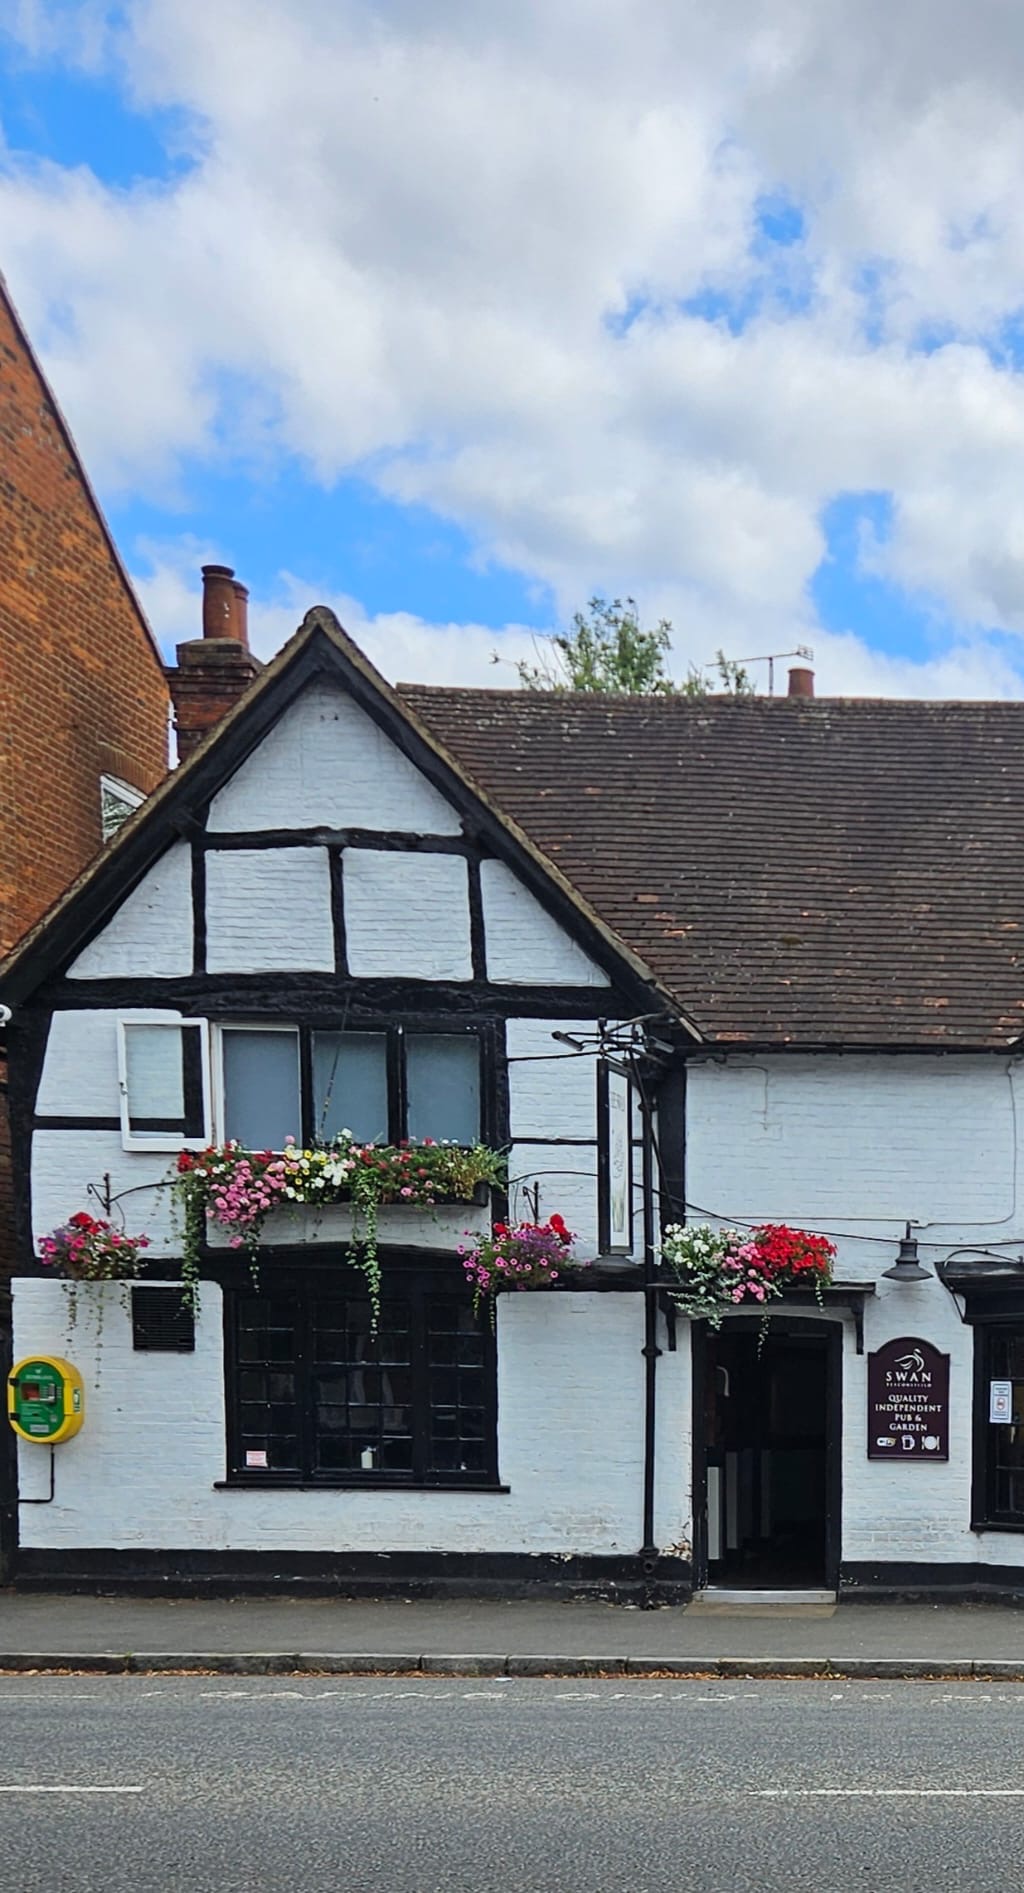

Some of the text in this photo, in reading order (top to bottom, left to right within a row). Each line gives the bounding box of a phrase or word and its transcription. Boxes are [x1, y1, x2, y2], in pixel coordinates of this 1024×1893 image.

[886, 1371, 931, 1382] SWAN
[888, 1394, 928, 1403] QUALITY
[875, 1403, 942, 1412] INDEPENDENT
[895, 1413, 912, 1421] PUB
[889, 1423, 927, 1431] GARDEN
